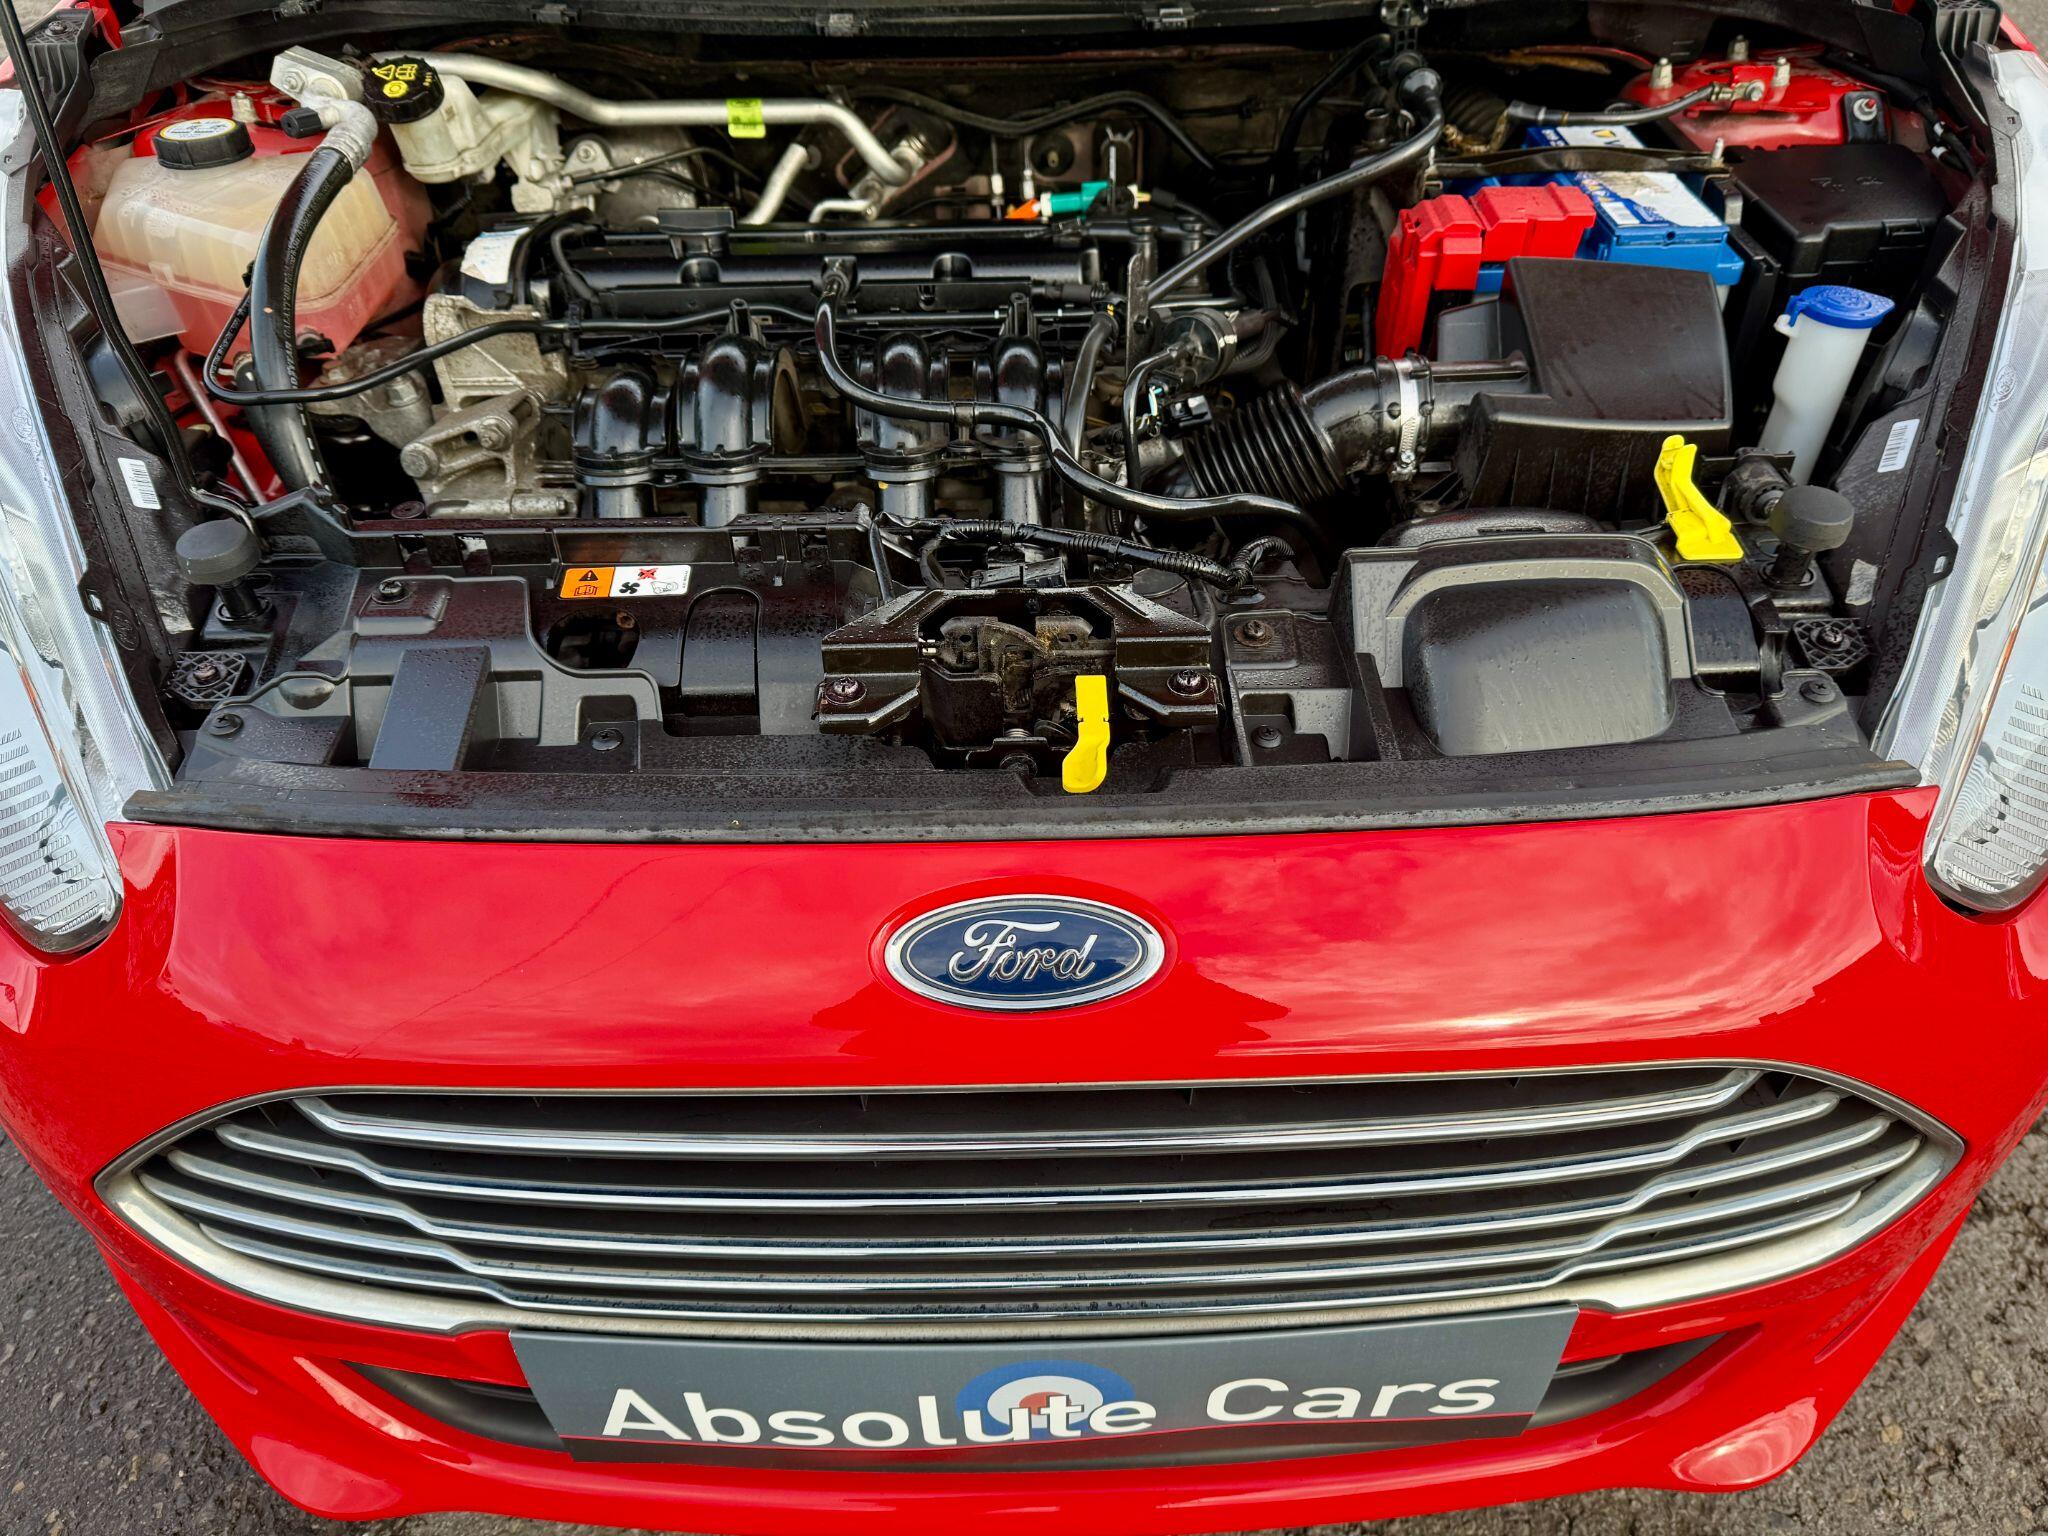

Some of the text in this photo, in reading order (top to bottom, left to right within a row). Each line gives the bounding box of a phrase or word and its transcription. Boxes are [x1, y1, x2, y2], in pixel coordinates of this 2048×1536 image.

[949, 919, 1098, 982] Ford
[602, 1378, 1501, 1447] Absolute Cars
